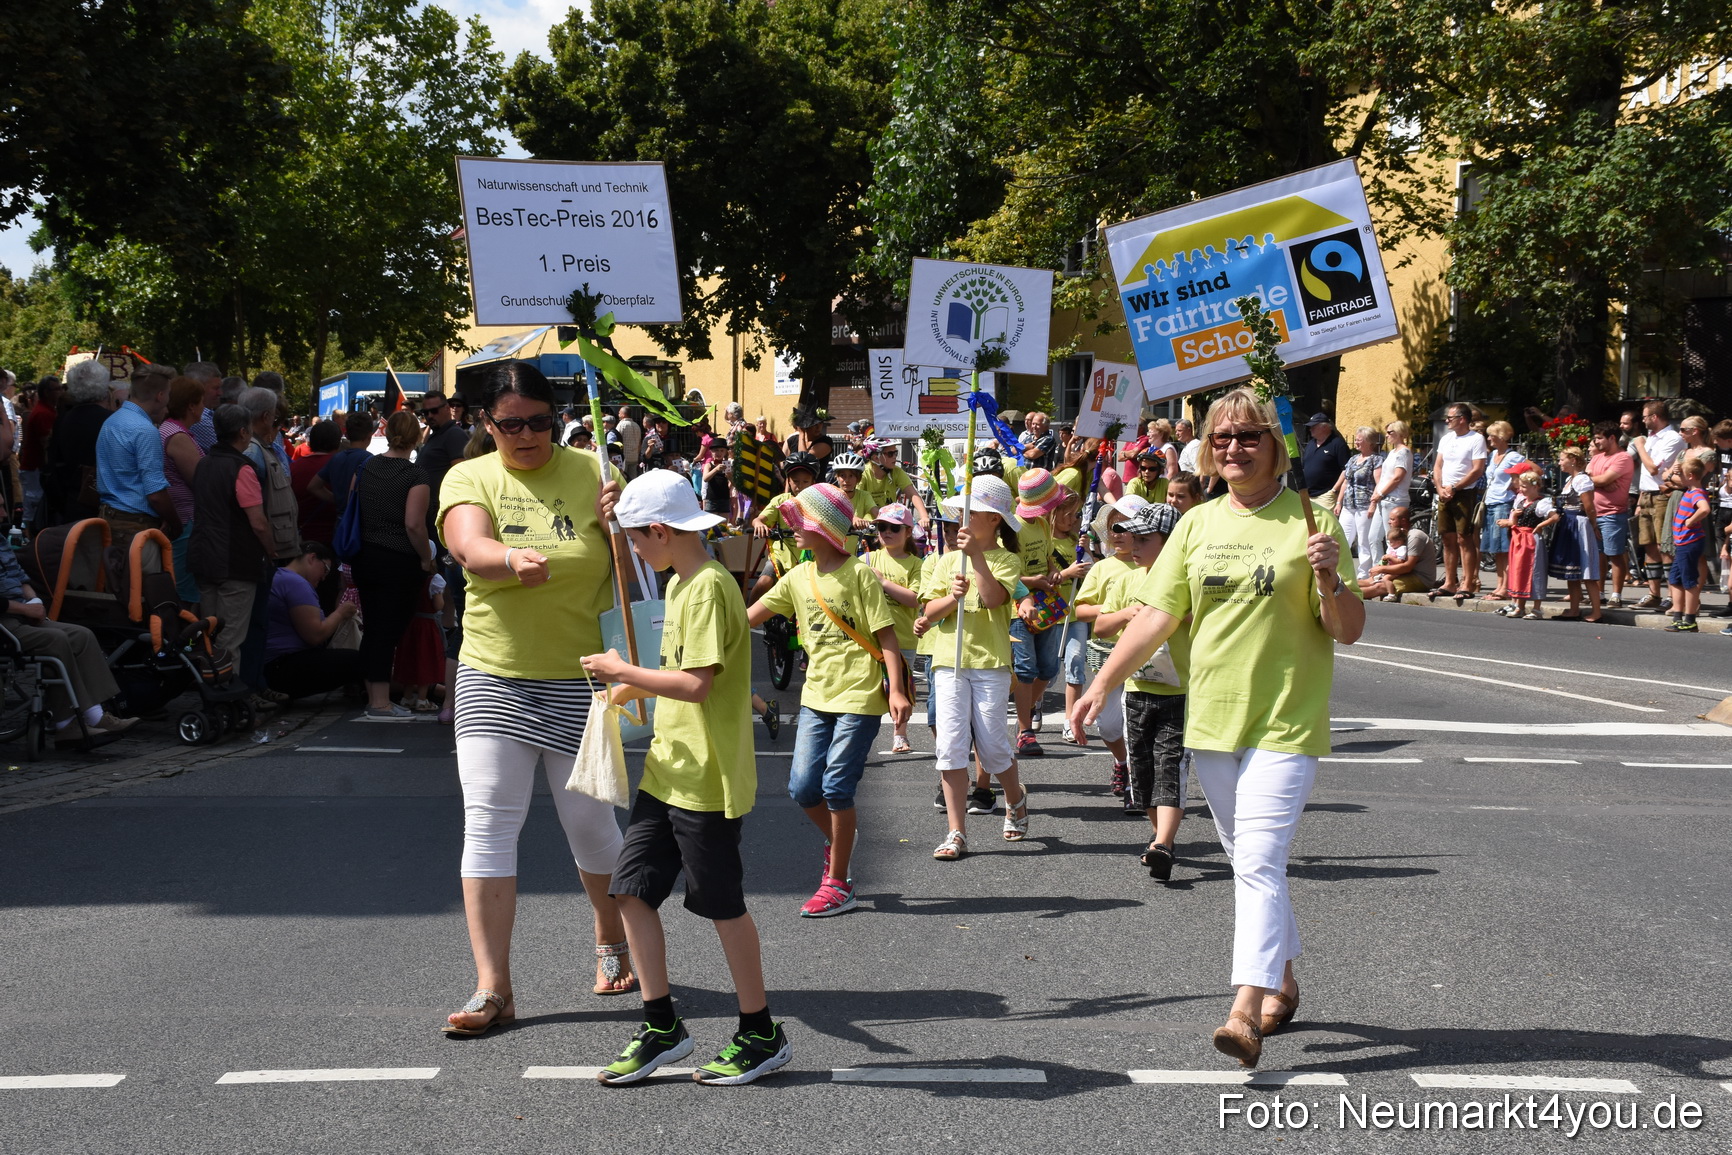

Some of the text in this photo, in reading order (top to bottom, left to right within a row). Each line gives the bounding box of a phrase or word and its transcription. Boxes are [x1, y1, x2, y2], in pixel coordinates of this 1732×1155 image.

[477, 178, 649, 193] Naturwissenschaft und Technik
[476, 207, 658, 229] BesTec-Preis 2016
[539, 254, 611, 273] 1. Preis
[933, 267, 1025, 313] UMWELTSCHULE IN EUROPA
[1127, 271, 1231, 313] Wir sind
[500, 295, 656, 308] Grundschule Oberpfalz
[1309, 295, 1373, 321] FAIRTRADE
[1321, 325, 1337, 334] Siegel
[1346, 319, 1363, 327] Fairen
[1362, 313, 1381, 322] Handel
[930, 310, 969, 364] INTERNATIONALE
[1181, 318, 1277, 363] Scho
[878, 355, 895, 400] SINUS
[888, 423, 987, 432] Wir sind SINUSSCHLE
[500, 494, 545, 504] Grundschule
[500, 503, 535, 512] Holzheim
[1204, 552, 1240, 560] Holzheim
[1206, 542, 1254, 551] Grundschule
